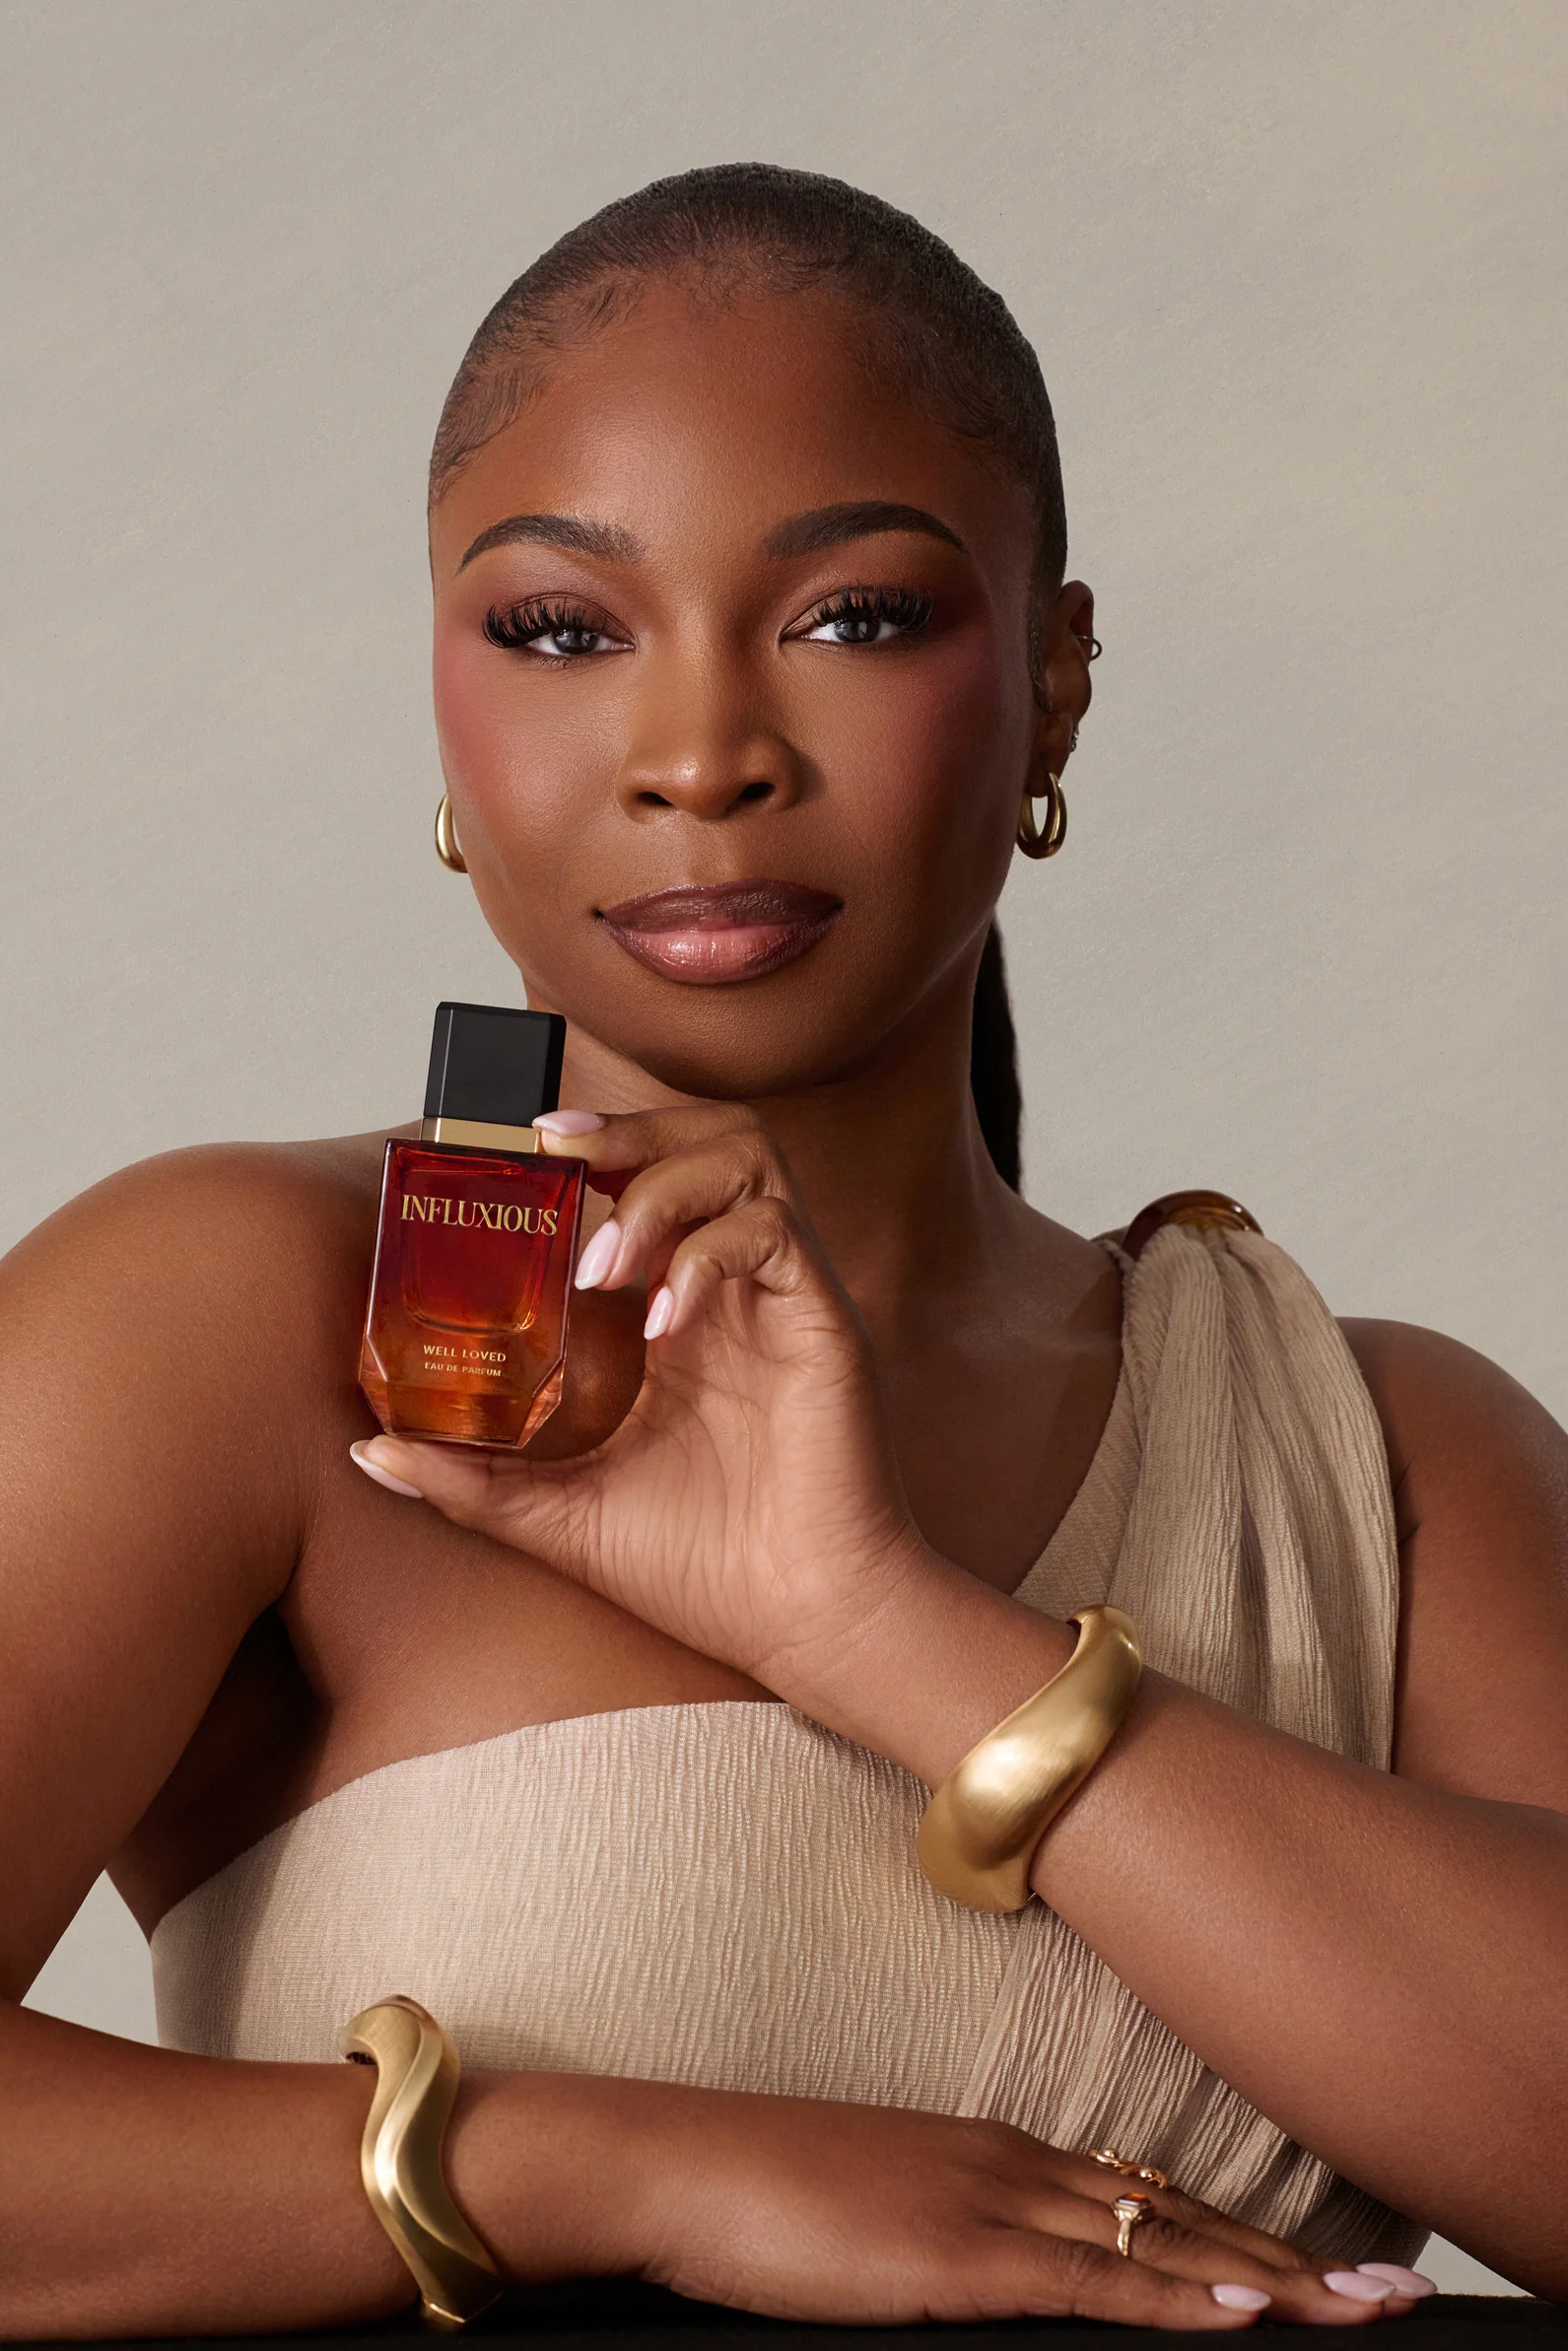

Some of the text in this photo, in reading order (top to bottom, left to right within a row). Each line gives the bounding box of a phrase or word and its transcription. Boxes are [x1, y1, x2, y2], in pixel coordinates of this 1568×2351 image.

[399, 1194, 558, 1236] INFLUXIOUS
[423, 1345, 507, 1362] WELL LOVED
[424, 1361, 444, 1371] EAU
[461, 1366, 502, 1377] PARFUM
